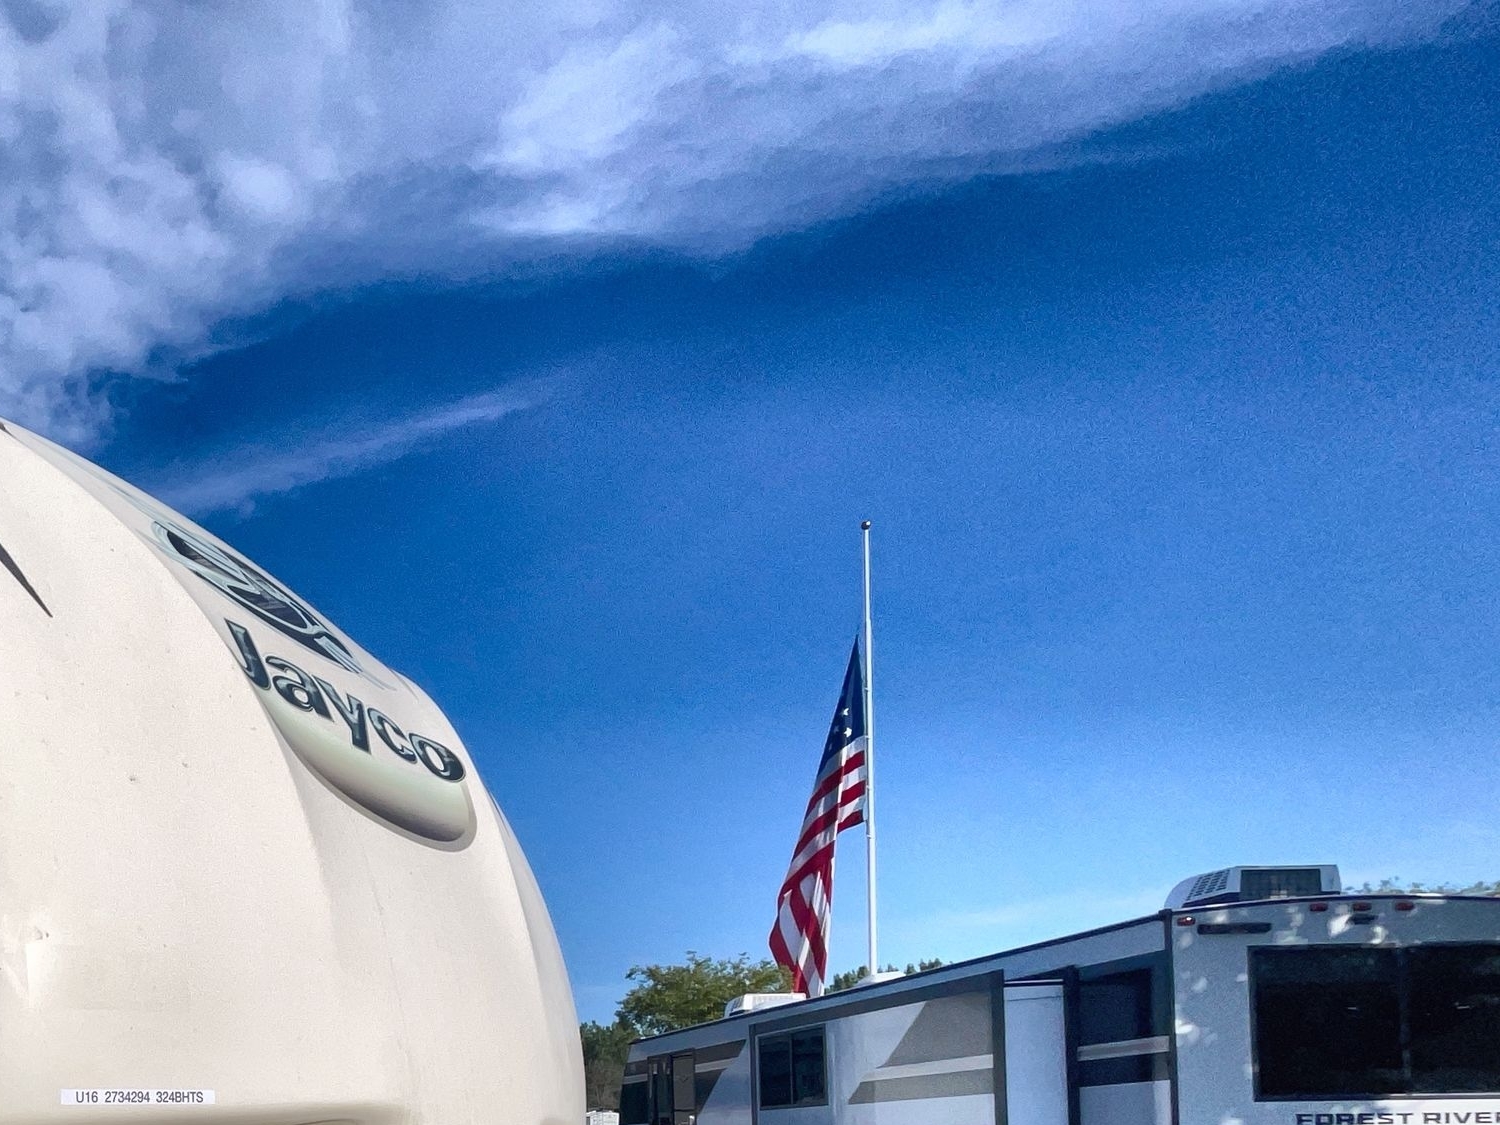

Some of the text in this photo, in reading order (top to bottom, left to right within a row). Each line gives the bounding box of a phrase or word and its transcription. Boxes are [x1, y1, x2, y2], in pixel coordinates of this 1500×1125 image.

[225, 618, 466, 783] Jayco
[75, 1091, 204, 1103] U16 2734294 324BHTS
[1295, 1111, 1500, 1125] FOREST RIVE
